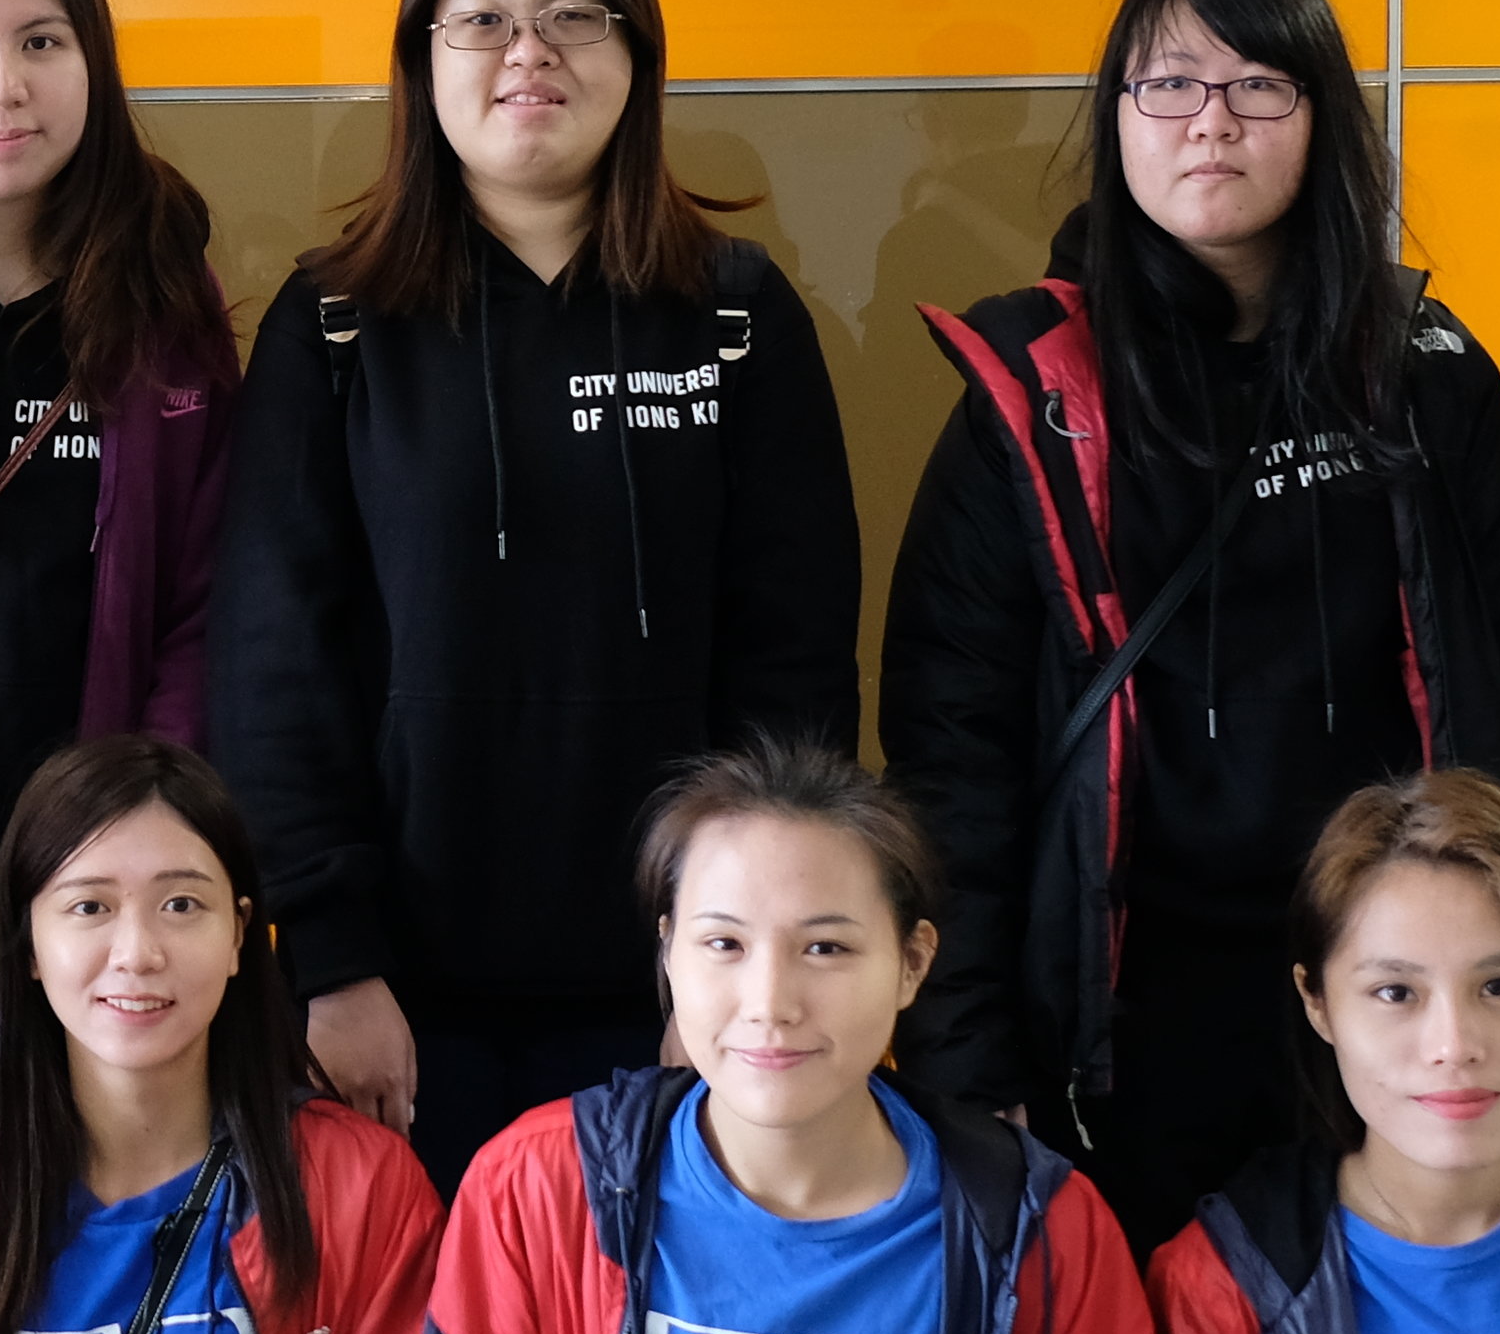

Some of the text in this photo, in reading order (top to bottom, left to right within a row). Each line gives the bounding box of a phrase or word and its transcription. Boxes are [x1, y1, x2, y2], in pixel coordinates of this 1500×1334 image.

[166, 388, 202, 409] NIKE
[569, 374, 618, 398] CITY
[14, 398, 53, 424] CIT
[572, 407, 604, 433] OF
[1254, 474, 1286, 499] OF
